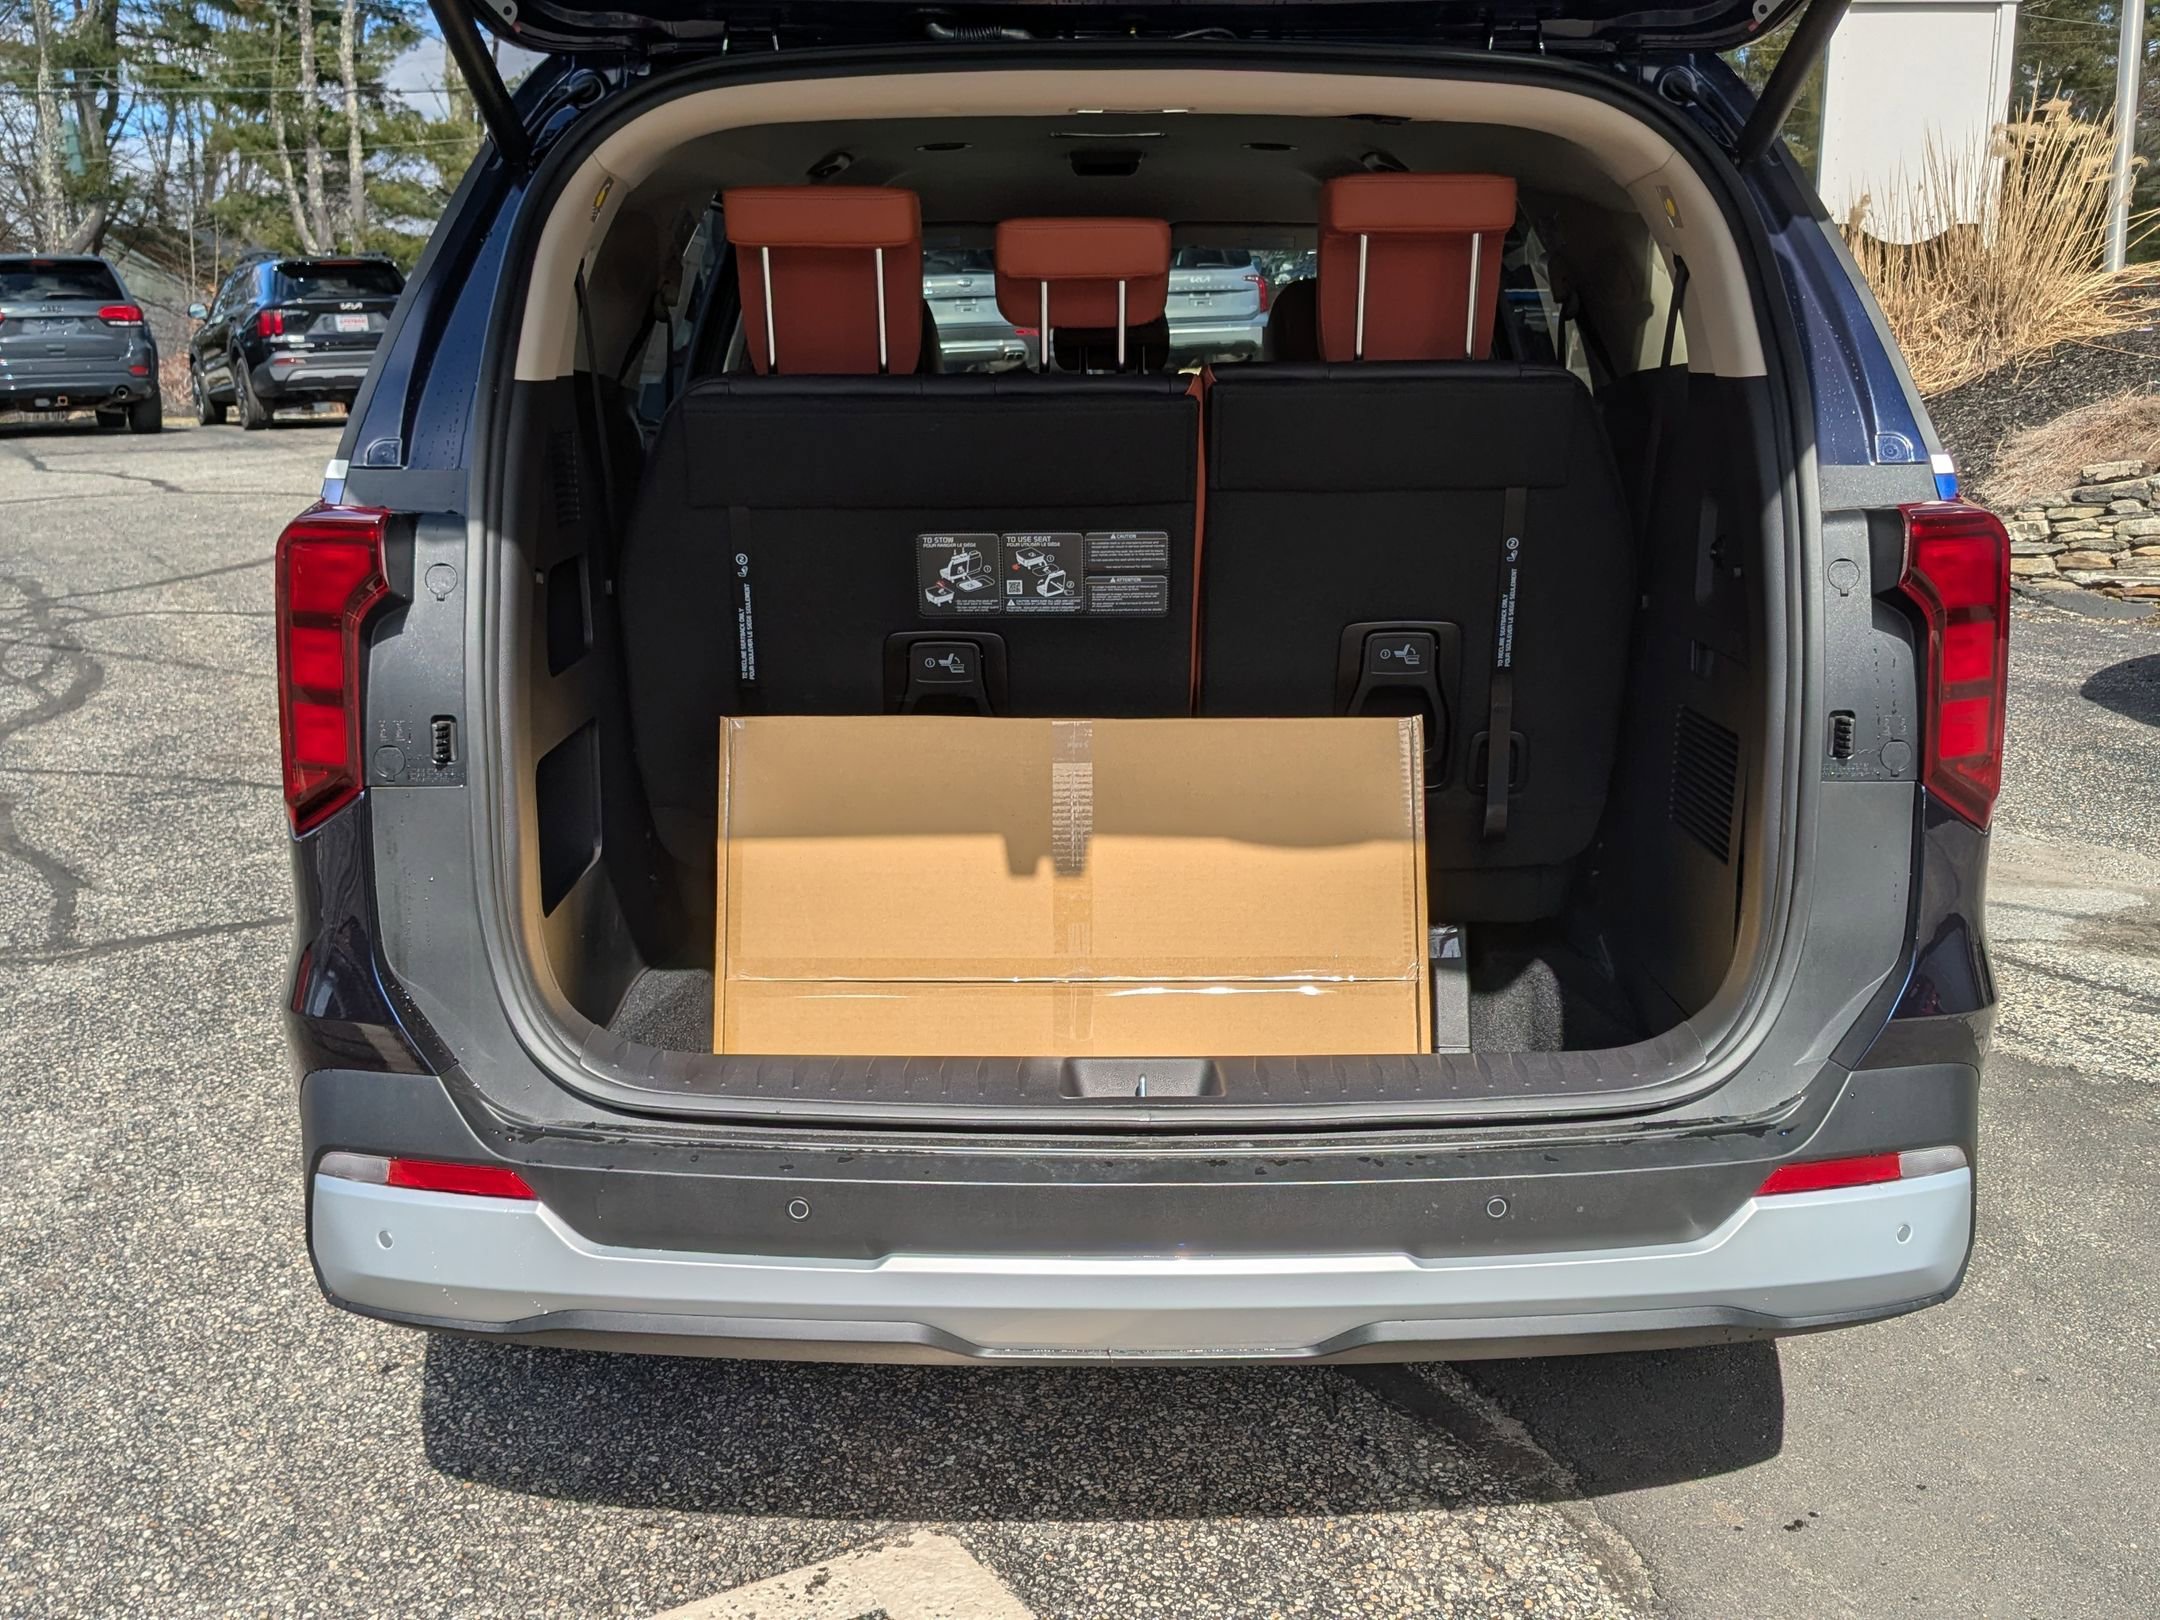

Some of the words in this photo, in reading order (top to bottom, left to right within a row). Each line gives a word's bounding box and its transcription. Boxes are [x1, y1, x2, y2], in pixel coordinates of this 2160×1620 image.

[923, 536, 933, 544] TO
[934, 536, 954, 544] STOW
[1033, 535, 1051, 543] SEAT
